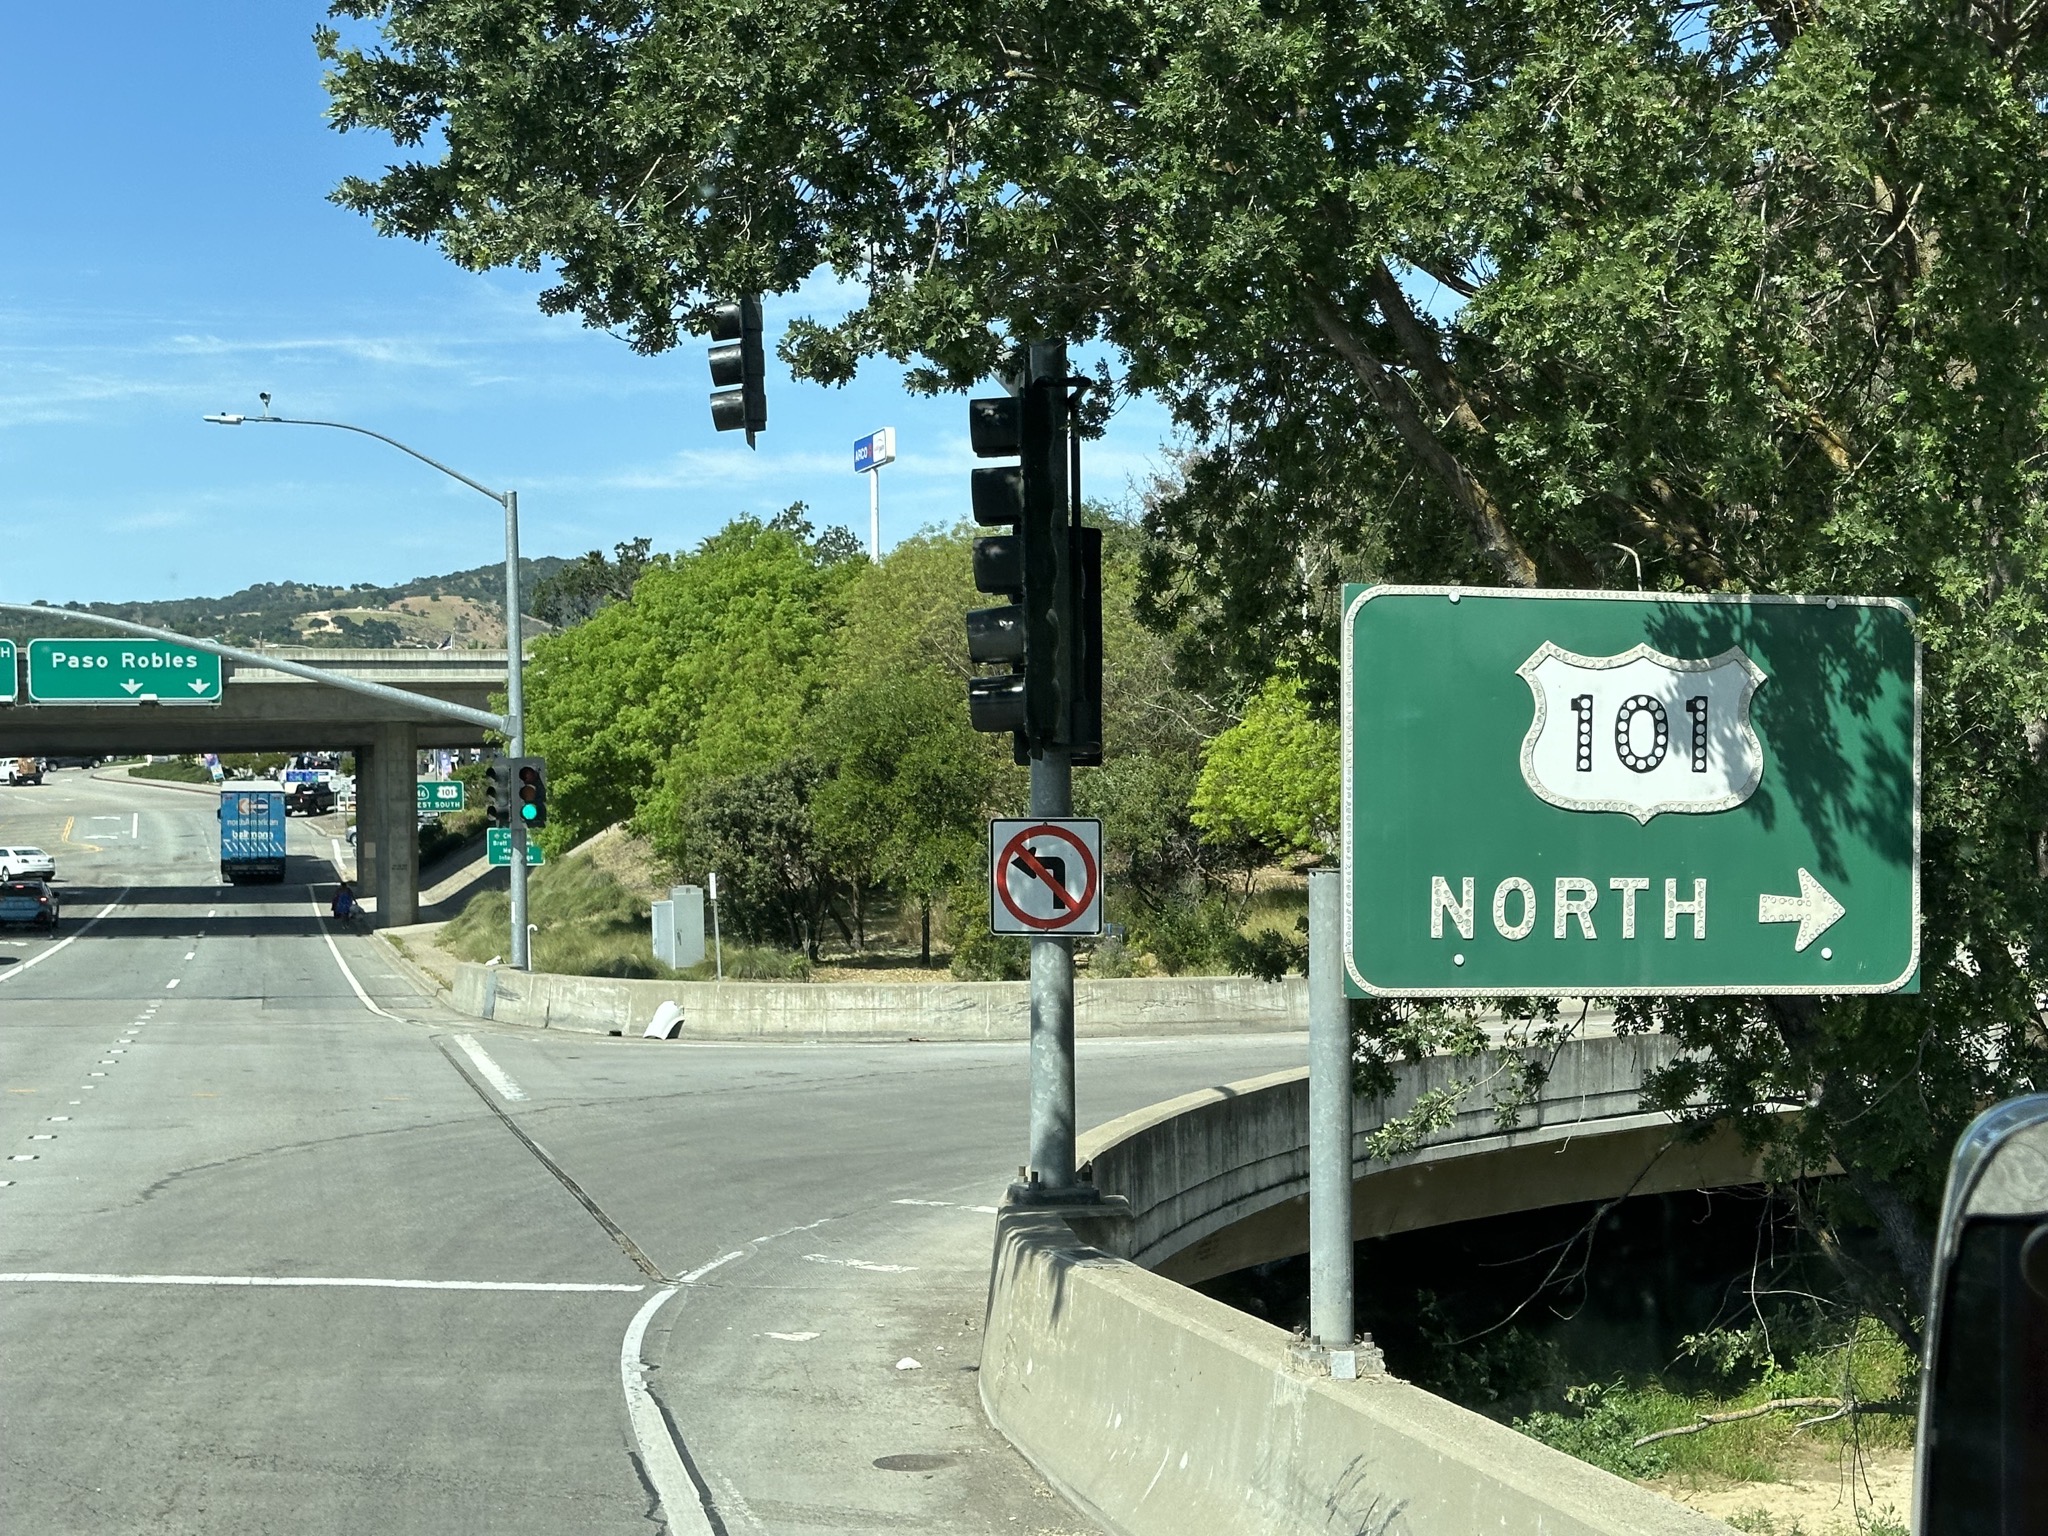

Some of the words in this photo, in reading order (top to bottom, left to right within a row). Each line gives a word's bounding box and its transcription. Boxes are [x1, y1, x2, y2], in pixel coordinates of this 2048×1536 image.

[52, 652, 109, 668] Paso
[121, 652, 198, 668] Robles
[1570, 694, 1708, 773] 101
[1430, 875, 1708, 941] NORTH
